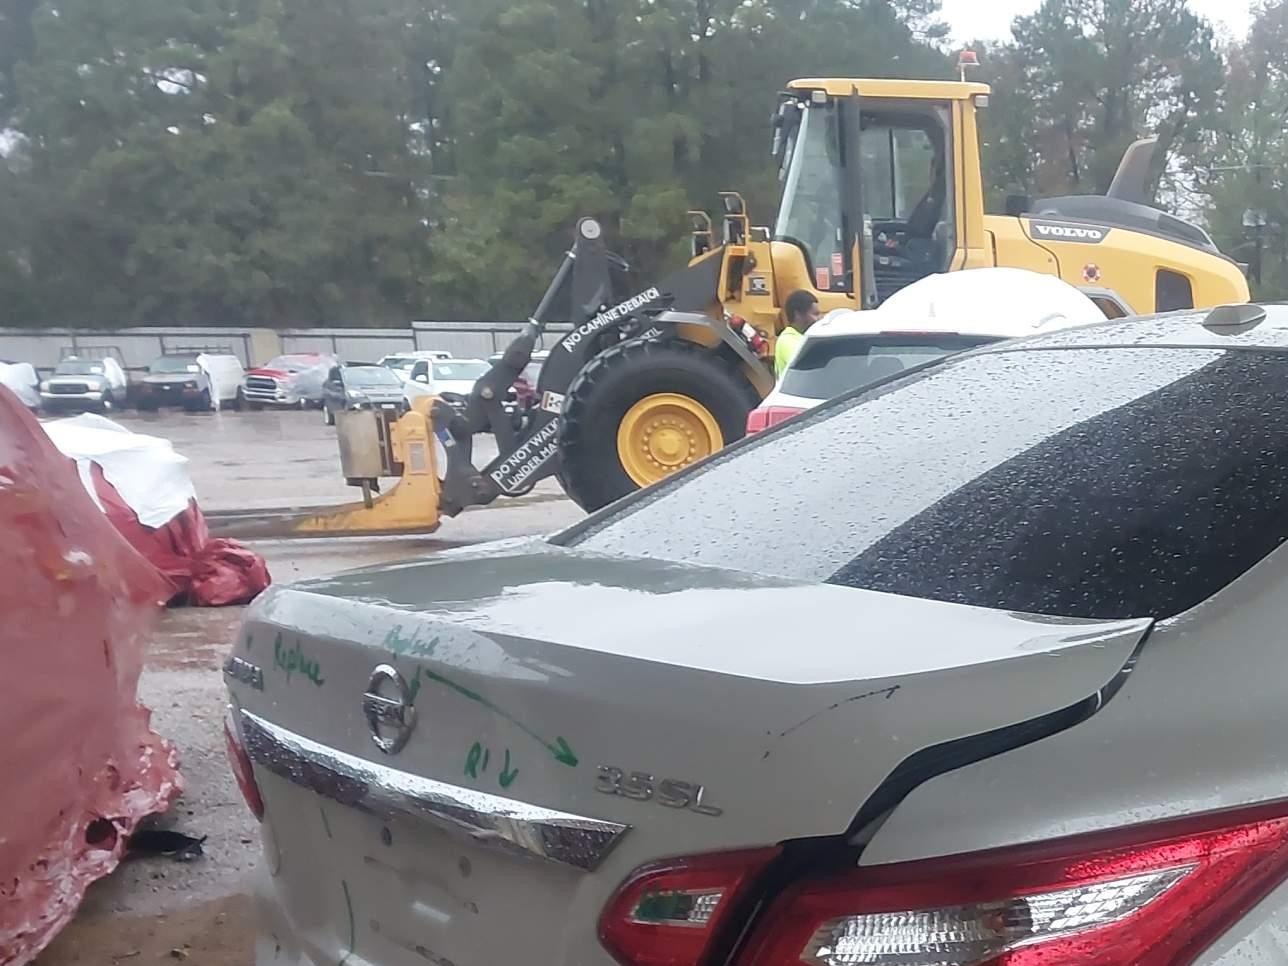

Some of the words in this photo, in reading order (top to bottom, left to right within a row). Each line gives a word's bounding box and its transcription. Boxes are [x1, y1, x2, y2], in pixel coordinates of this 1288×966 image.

[1035, 225, 1102, 239] VOLVO
[561, 332, 582, 353] NO
[579, 311, 620, 336] CAMINE
[619, 287, 657, 316] DEBAJO
[492, 464, 510, 481] DO
[509, 445, 533, 466] NOT
[530, 417, 560, 447] WALK
[507, 455, 542, 485] UNDER
[656, 778, 723, 817] SL
